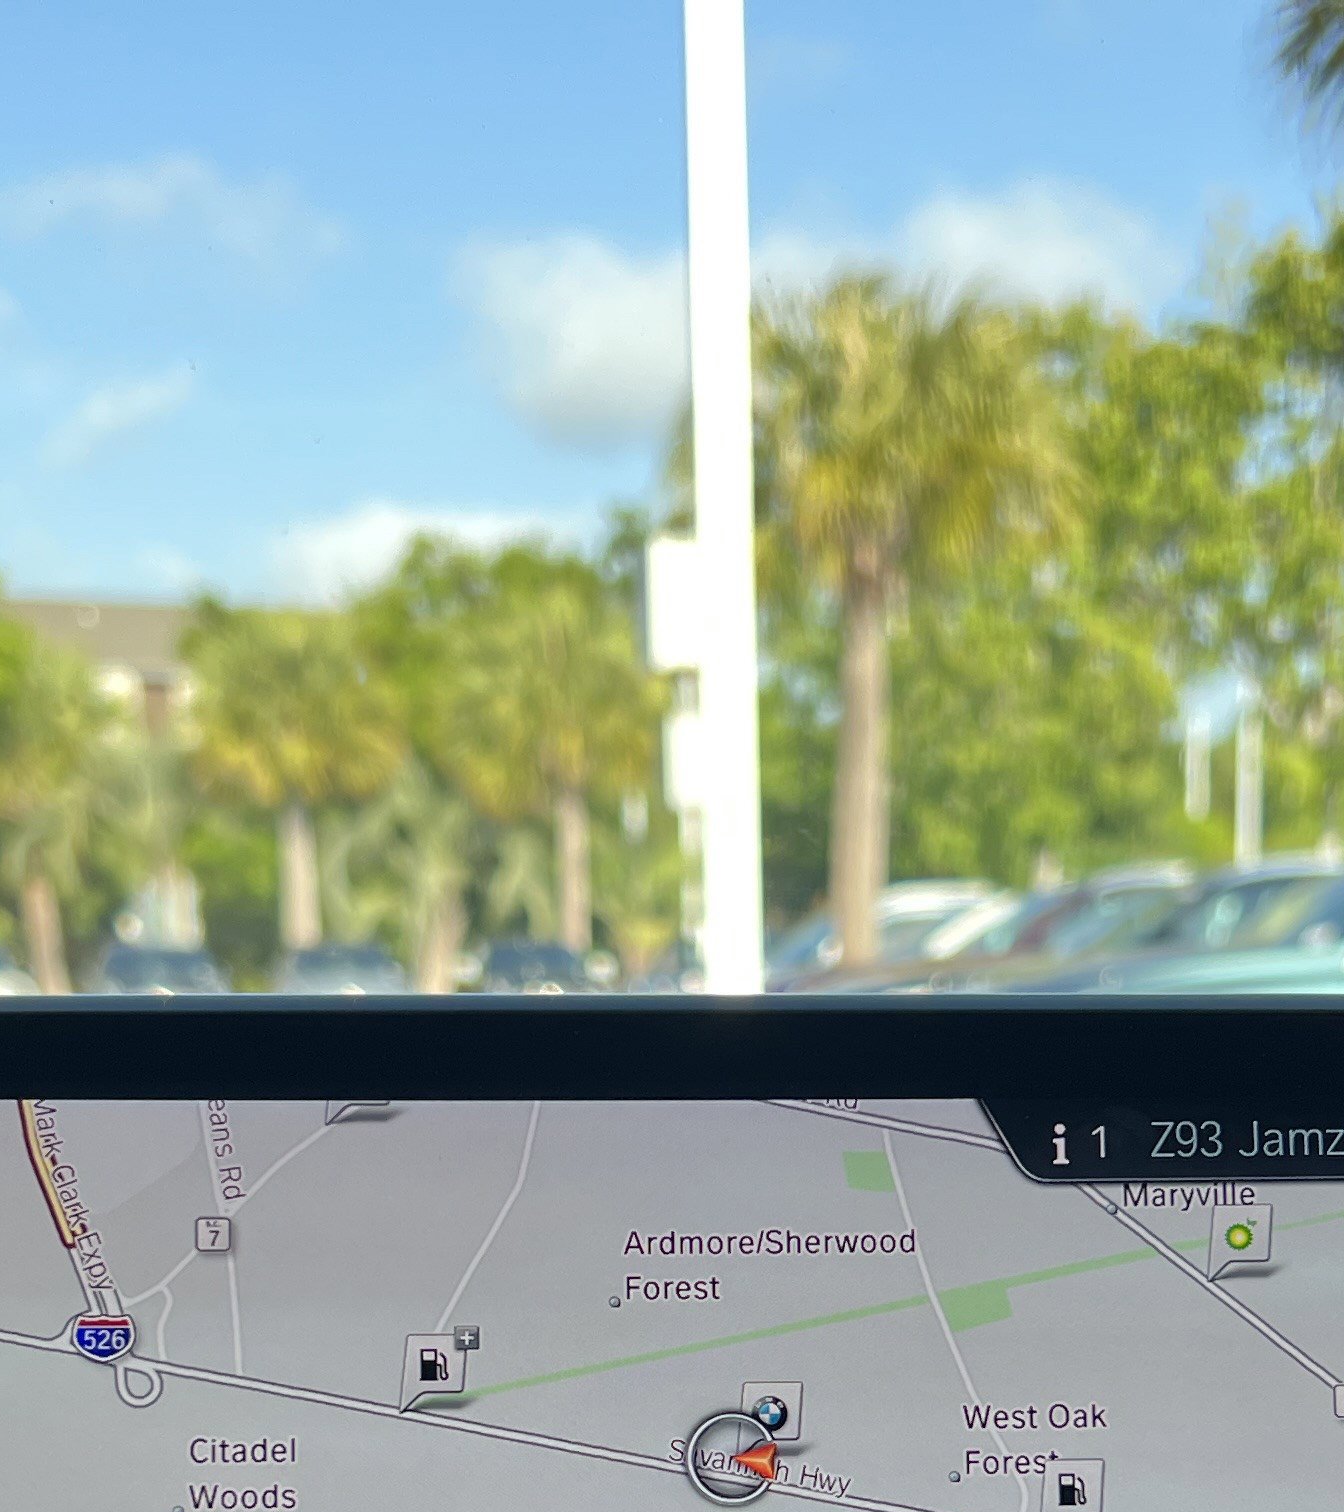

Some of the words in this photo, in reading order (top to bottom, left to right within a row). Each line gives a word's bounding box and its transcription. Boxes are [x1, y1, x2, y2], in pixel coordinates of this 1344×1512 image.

[1150, 1120, 1224, 1158] Z93
[33, 1099, 64, 1158] Mark
[52, 1164, 90, 1229] Clark
[77, 1231, 114, 1290] Expy
[218, 1166, 247, 1200] Rd
[1122, 1182, 1256, 1212] Maryville
[208, 1229, 220, 1247] 7
[623, 1228, 916, 1255] Ardmore/Sherwood
[625, 1275, 721, 1301] Forest
[83, 1329, 126, 1350] 526
[962, 1404, 1038, 1429] West
[1048, 1403, 1107, 1429] Oak
[189, 1438, 296, 1464] Citadel
[800, 1464, 852, 1498] Hwy
[188, 1484, 297, 1509] Woods
